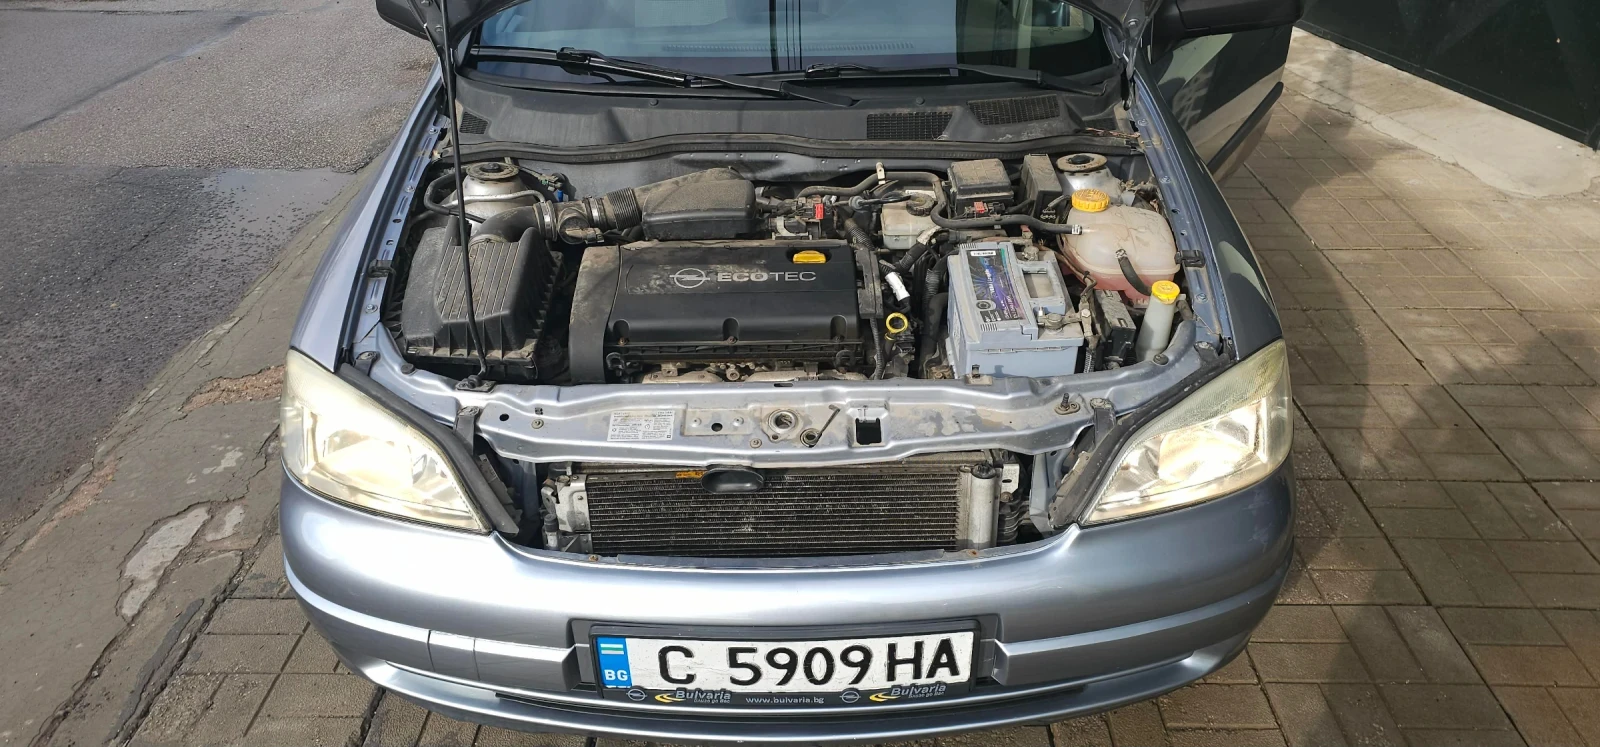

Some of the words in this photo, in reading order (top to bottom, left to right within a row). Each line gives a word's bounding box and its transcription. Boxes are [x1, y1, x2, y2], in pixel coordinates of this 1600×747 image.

[717, 272, 816, 282] ECOTEC
[658, 645, 697, 685] C
[728, 645, 874, 686] 5909
[887, 638, 960, 682] HA
[605, 669, 628, 681] BG
[675, 690, 731, 700] Bulvaria
[891, 684, 947, 696] Bulvaria
